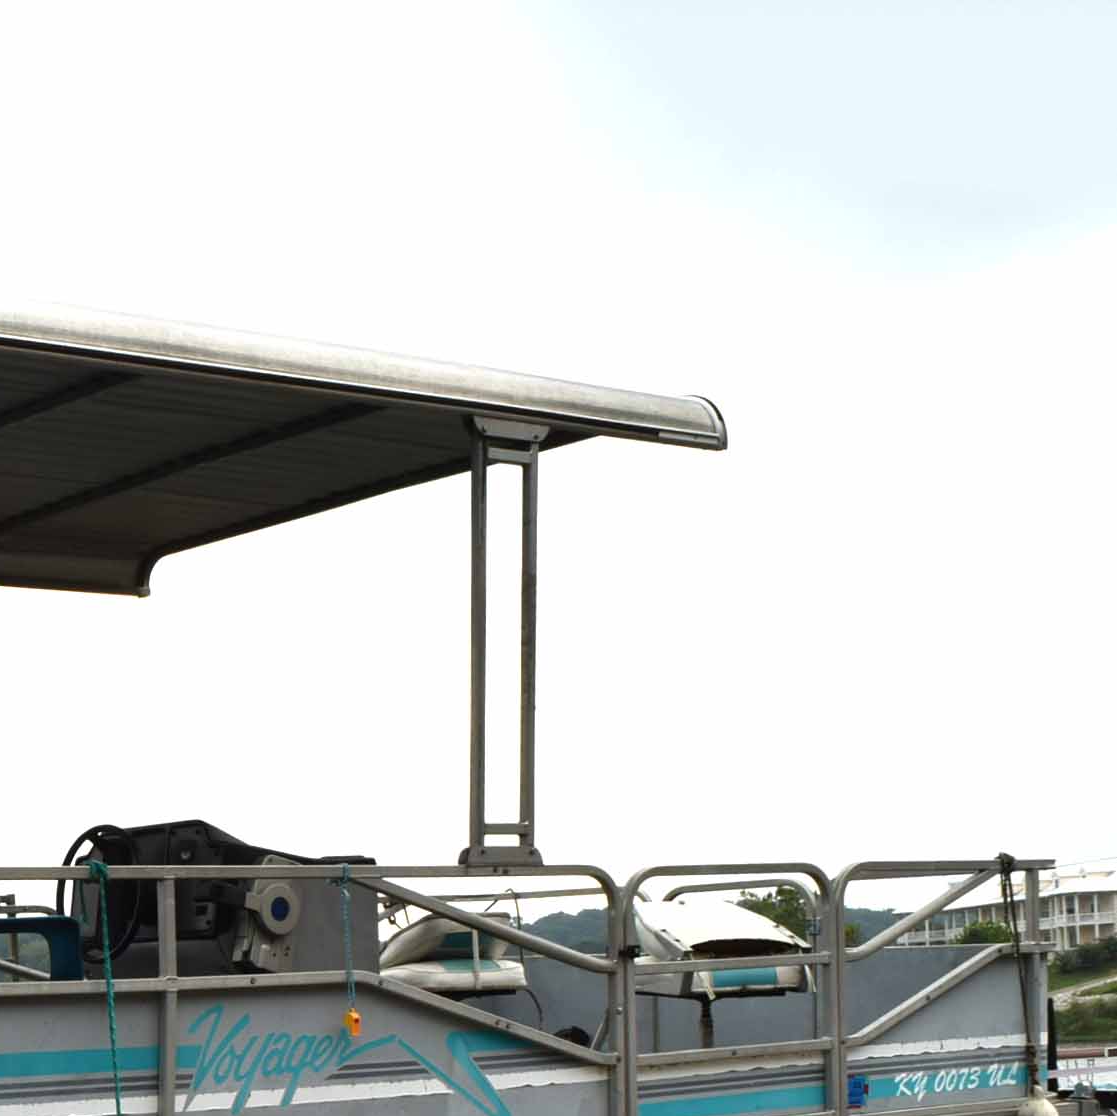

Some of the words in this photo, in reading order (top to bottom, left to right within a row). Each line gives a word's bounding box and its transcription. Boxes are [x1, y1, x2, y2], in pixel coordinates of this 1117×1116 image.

[183, 1002, 366, 1116] Voyager
[894, 1073, 927, 1102] KY
[934, 1067, 981, 1092] 0073
